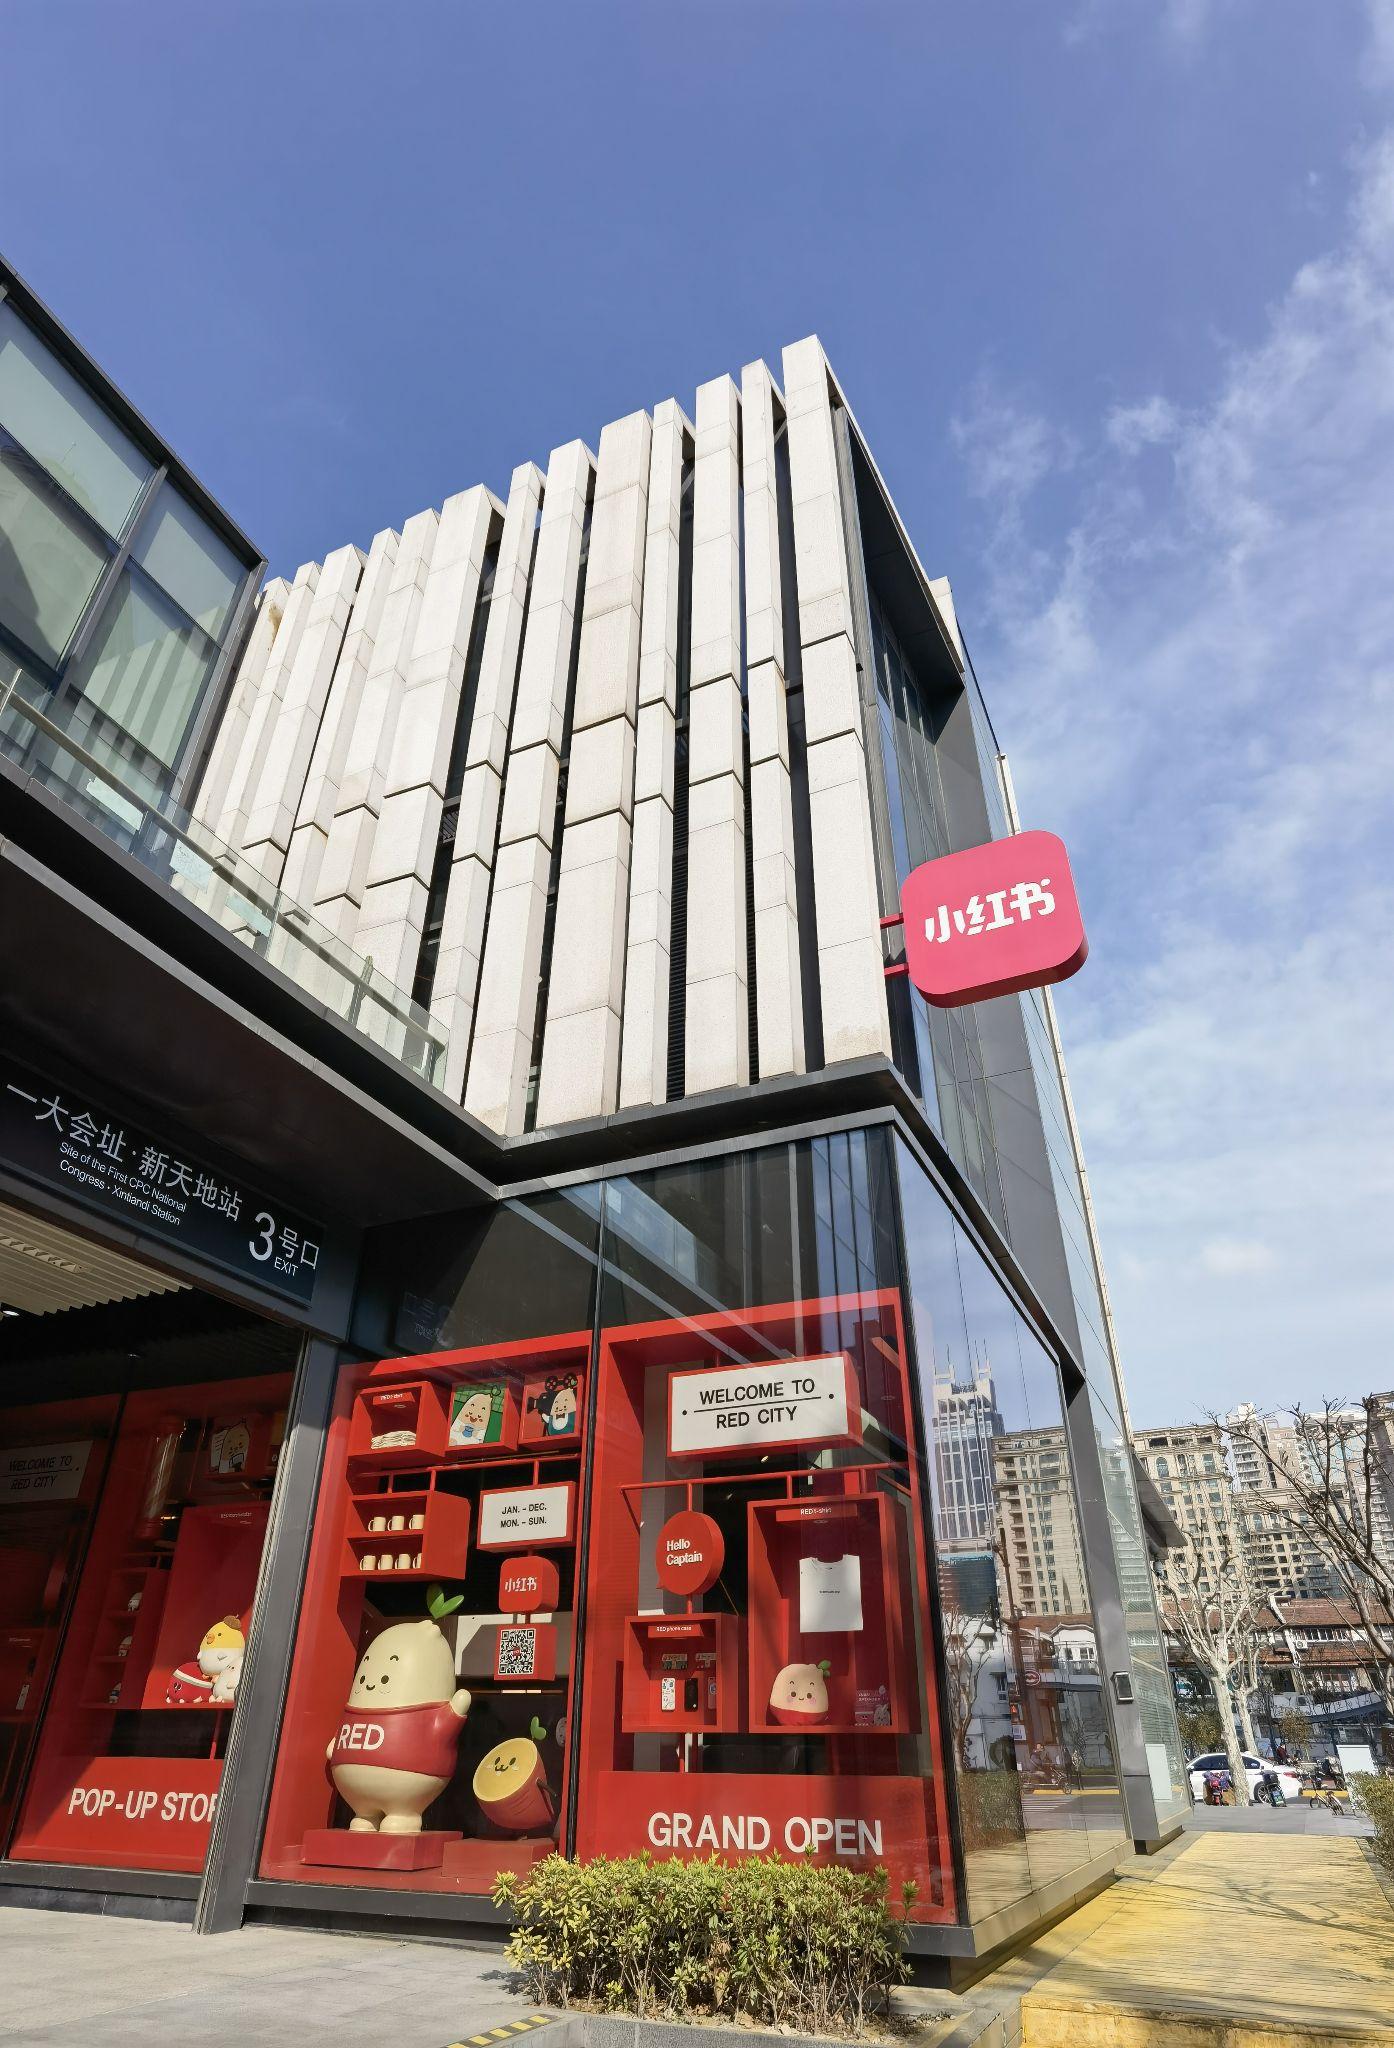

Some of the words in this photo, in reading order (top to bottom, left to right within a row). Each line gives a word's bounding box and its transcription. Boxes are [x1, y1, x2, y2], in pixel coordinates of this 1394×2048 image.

[924, 878, 1056, 943] 小红书
[60, 1142, 79, 1159] Site
[80, 1154, 92, 1165] of
[91, 1158, 106, 1173] the
[107, 1166, 129, 1185] First
[129, 1177, 151, 1195] CPC
[151, 1187, 187, 1213] National
[60, 1159, 105, 1190] Congress
[111, 1185, 151, 1212] Xintiandi
[151, 1204, 181, 1226] Station
[274, 1256, 299, 1277] EXIT
[700, 1382, 784, 1405] WELCOME
[791, 1378, 816, 1395] TO
[716, 1411, 750, 1429] RED
[757, 1406, 798, 1424] CITY
[10, 1457, 57, 1473] WELCOME
[60, 1455, 73, 1467] TO
[10, 1478, 31, 1490] RED
[33, 1475, 58, 1489] CITY
[501, 1505, 520, 1515] JAN.
[528, 1502, 547, 1512] DEC.
[500, 1518, 520, 1529] MON.
[528, 1516, 547, 1526] SUN.
[666, 1538, 691, 1551] Hello
[666, 1551, 703, 1567] Captain
[504, 1576, 538, 1593] 小红书
[337, 1723, 385, 1750] RED
[67, 1788, 158, 1819] POP-UP
[647, 1811, 771, 1850] GRAND
[784, 1816, 884, 1856] OPEN
